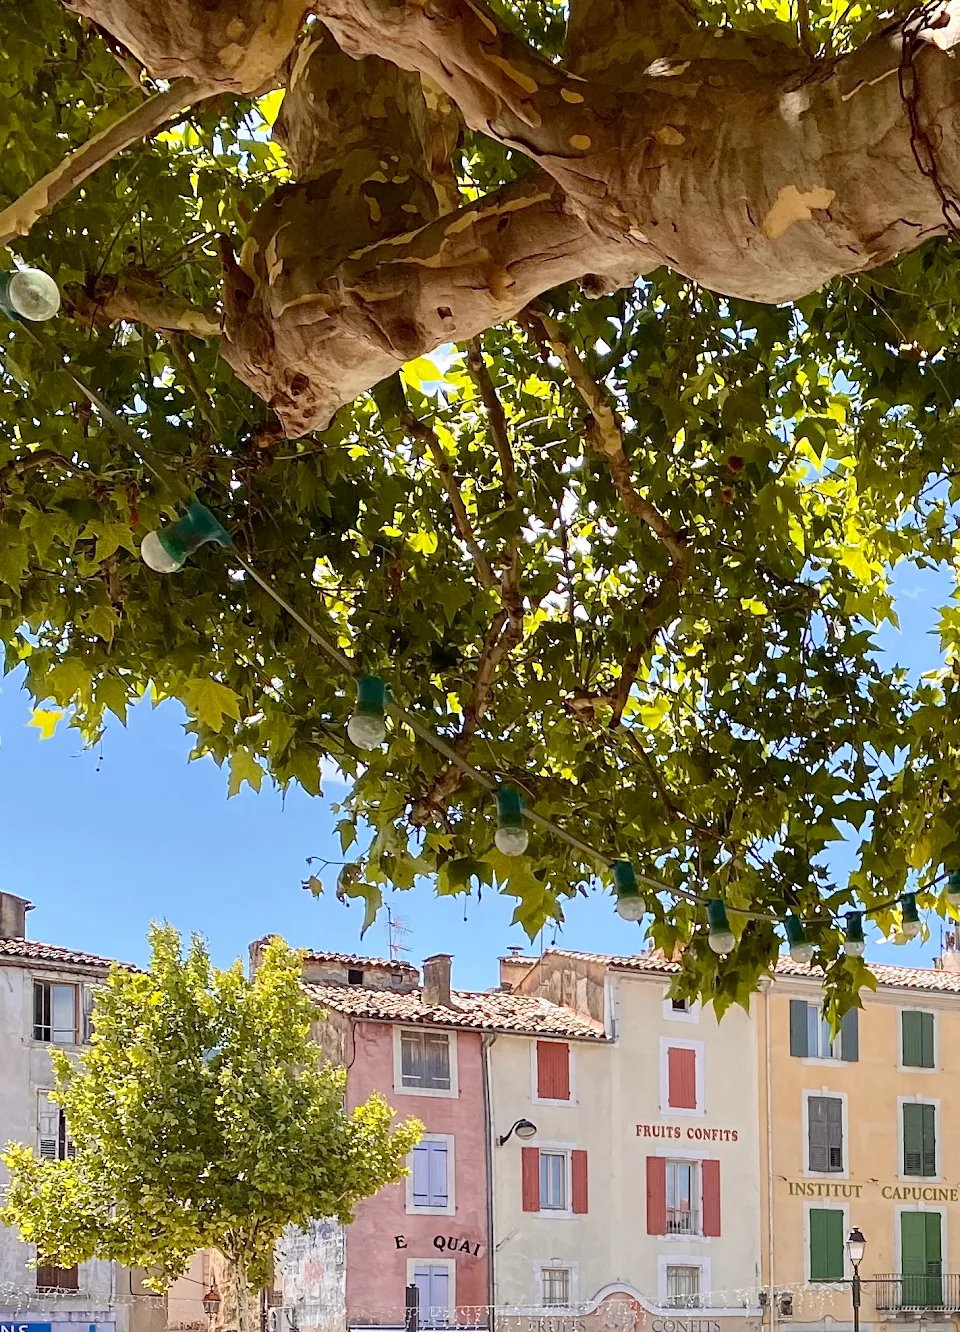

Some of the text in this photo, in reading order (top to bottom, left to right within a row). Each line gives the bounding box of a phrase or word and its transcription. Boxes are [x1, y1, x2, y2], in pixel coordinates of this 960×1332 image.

[636, 1125, 738, 1141] FRUITS CONFITS
[788, 1182, 862, 1198] INSTITUT
[881, 1186, 958, 1201] CAPUCINE
[433, 1235, 481, 1257] QUAI
[529, 1319, 587, 1332] FRUITS
[652, 1319, 721, 1332] CONFITS
